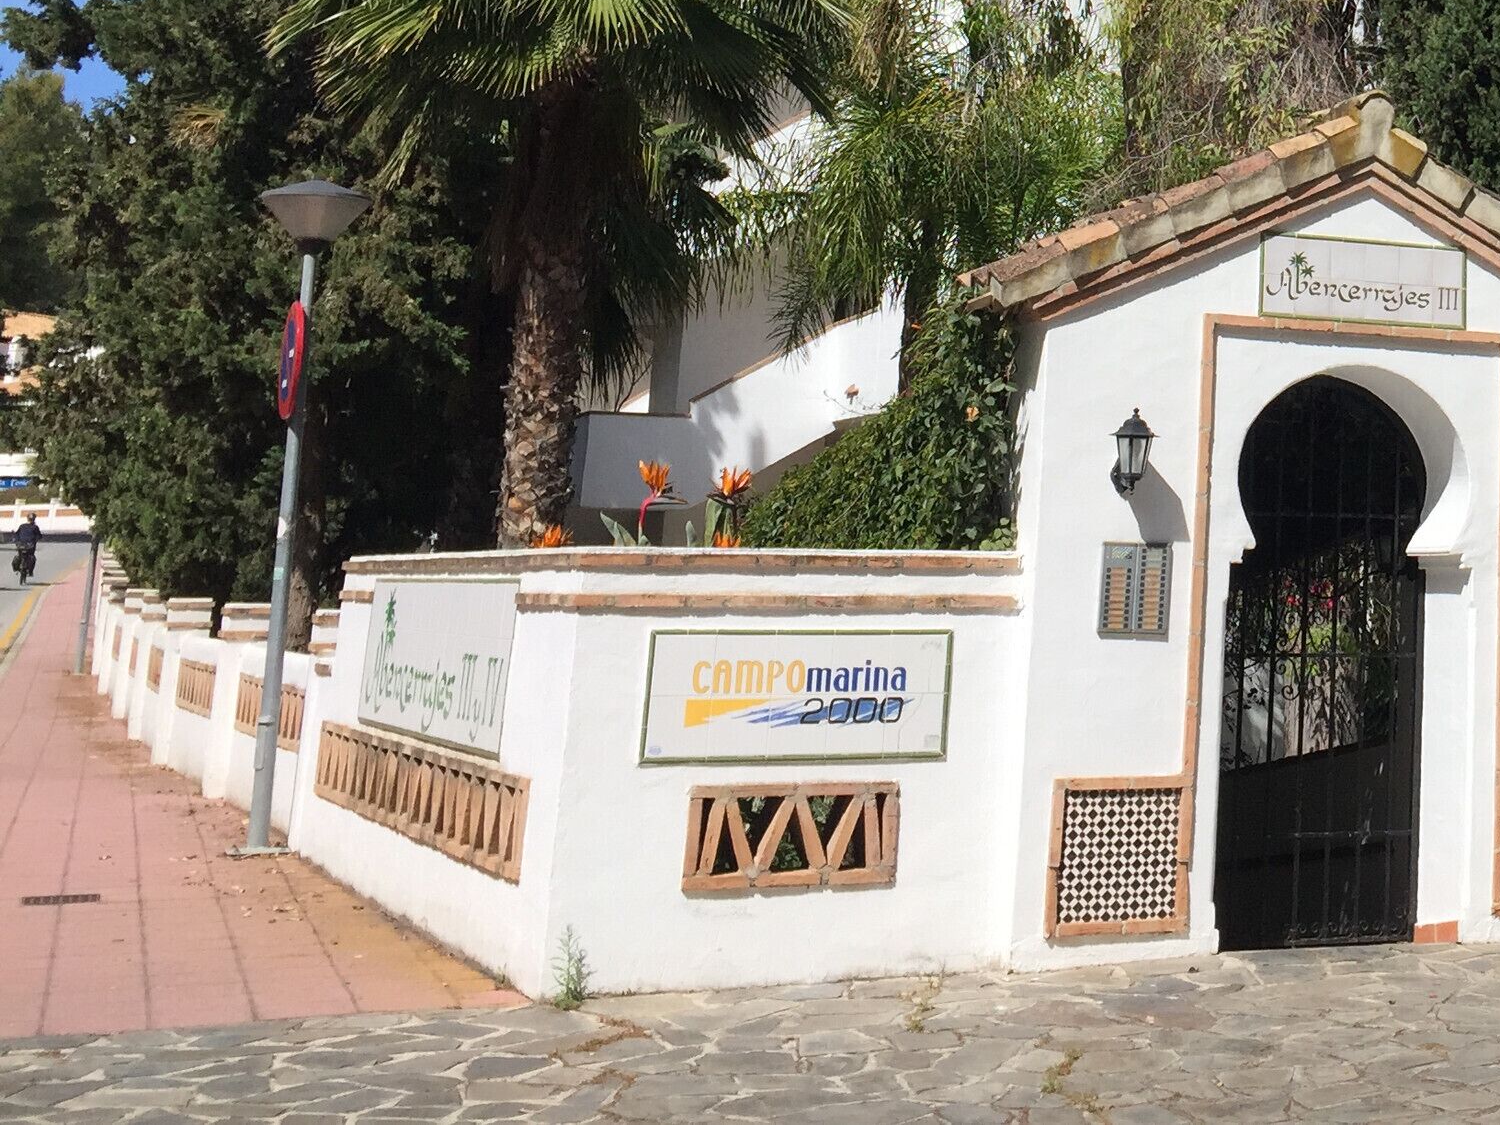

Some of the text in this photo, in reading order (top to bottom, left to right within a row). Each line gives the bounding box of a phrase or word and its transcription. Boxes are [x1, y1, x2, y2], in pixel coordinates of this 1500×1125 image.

[1266, 266, 1460, 312] Abencerrajes III
[800, 696, 905, 725] 2000
